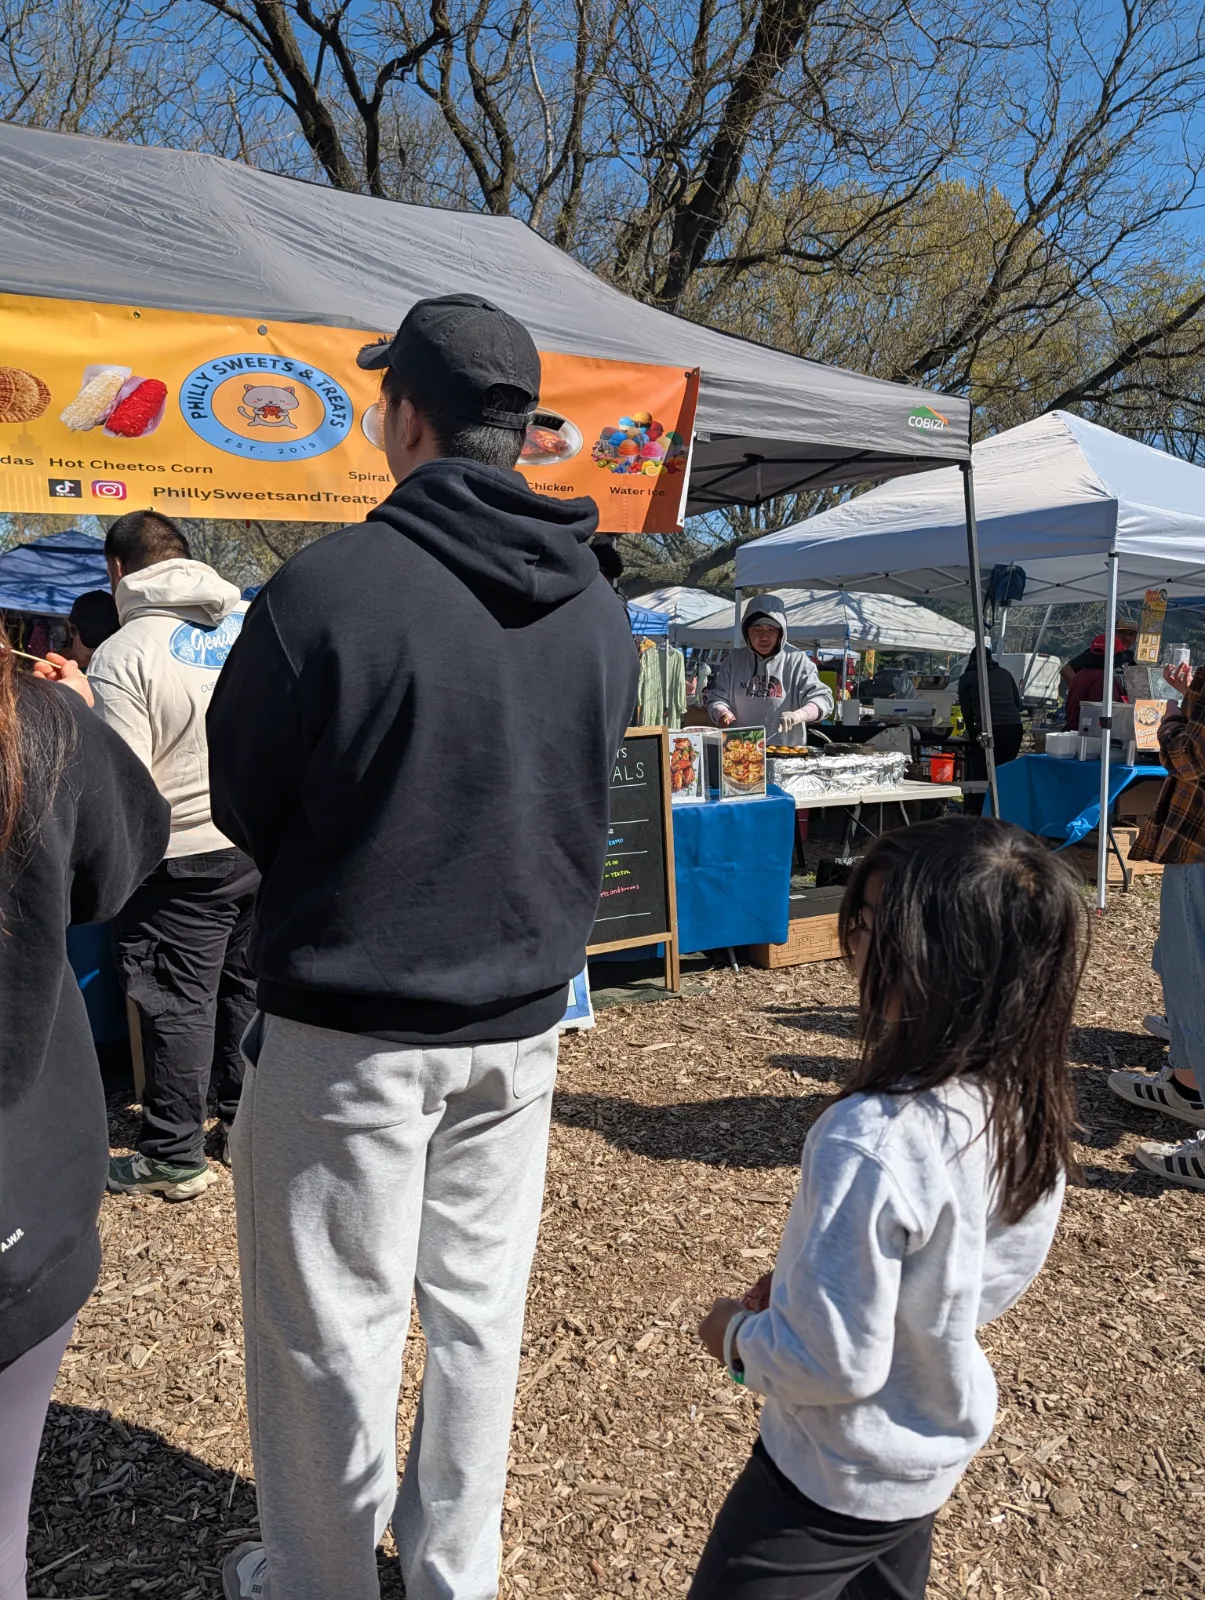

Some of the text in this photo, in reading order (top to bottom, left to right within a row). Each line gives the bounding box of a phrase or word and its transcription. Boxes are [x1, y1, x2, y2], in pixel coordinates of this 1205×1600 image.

[187, 357, 347, 429] PHILLY SWEETS & TREATS
[224, 437, 317, 455] EST. 2019
[49, 457, 213, 474] Hot Cheetos Corn
[348, 471, 391, 483] Spiral
[153, 486, 378, 504] PhillySweetsandTreats
[527, 482, 574, 493] Chicken
[609, 486, 666, 497] Water Ice
[612, 761, 645, 783] ALS
